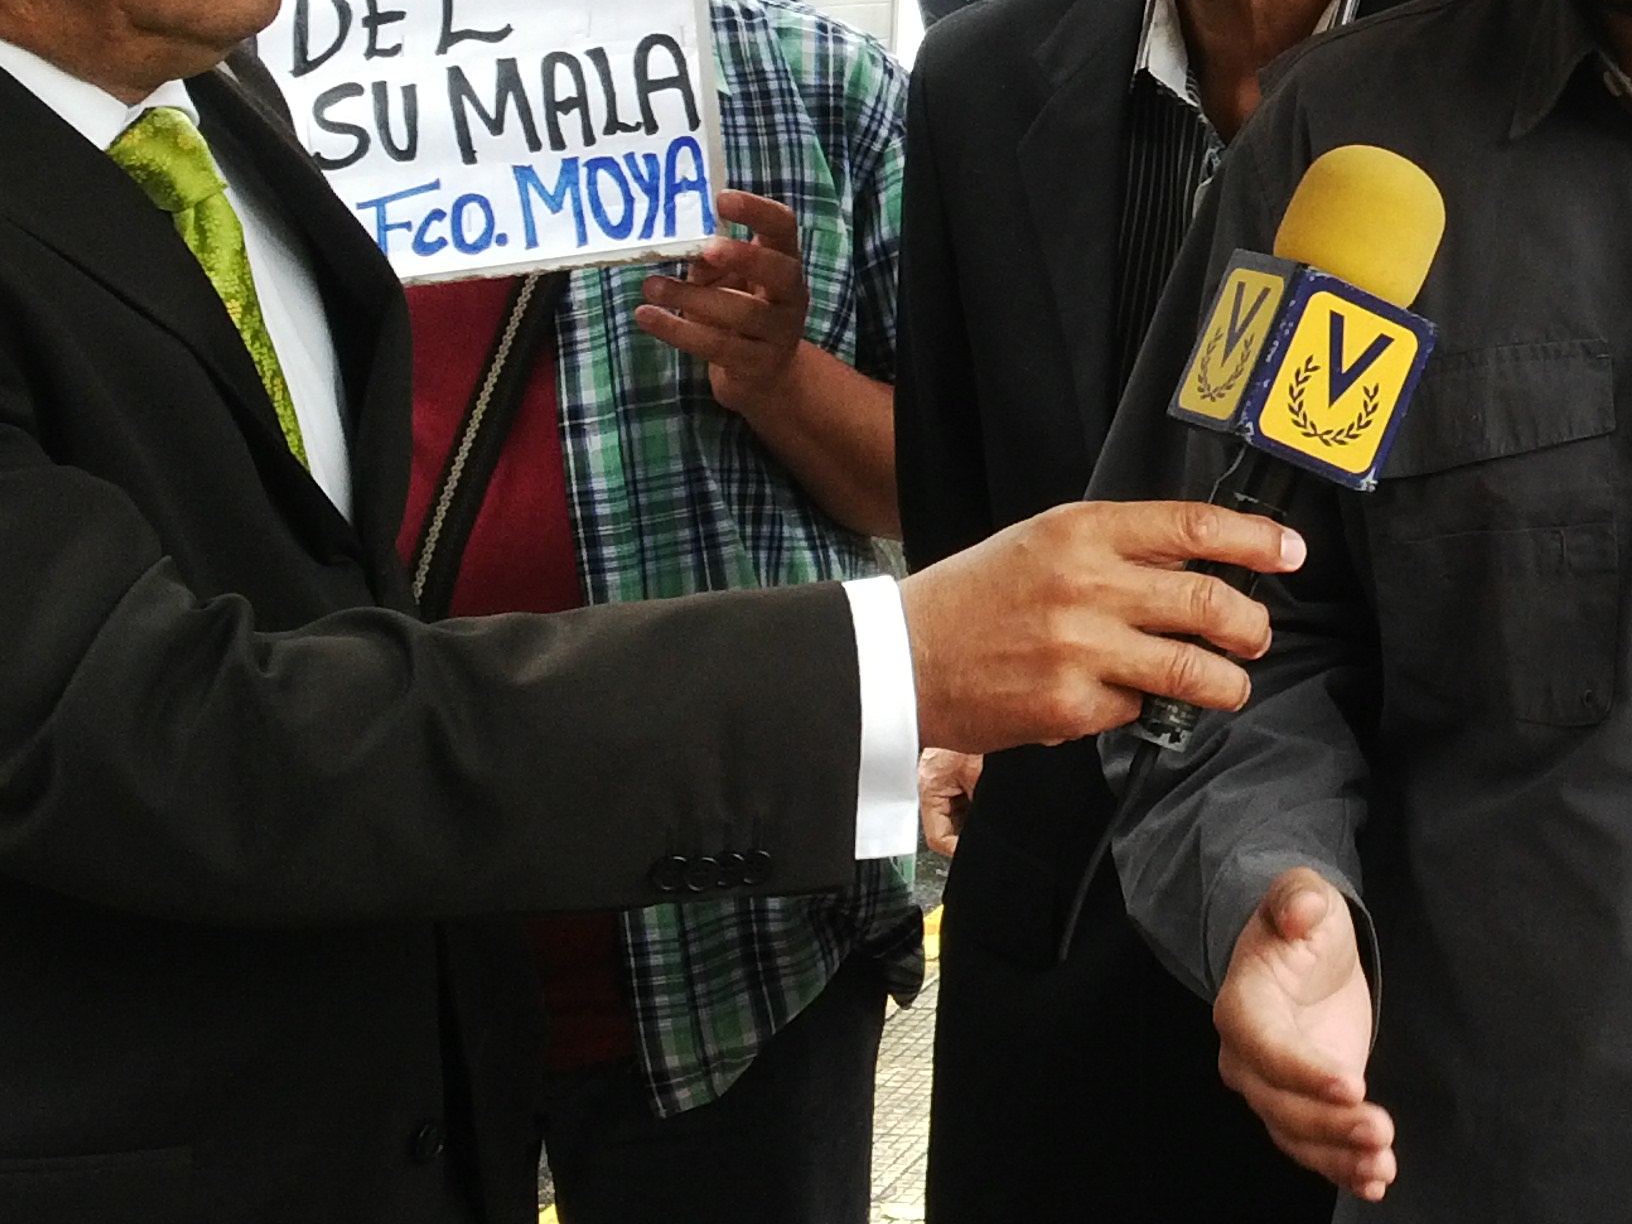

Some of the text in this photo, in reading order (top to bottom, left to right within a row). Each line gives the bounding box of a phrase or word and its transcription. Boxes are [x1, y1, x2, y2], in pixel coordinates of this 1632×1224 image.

[313, 34, 702, 170] SU MALA
[513, 136, 719, 250] MOYA
[1328, 309, 1395, 409] V
